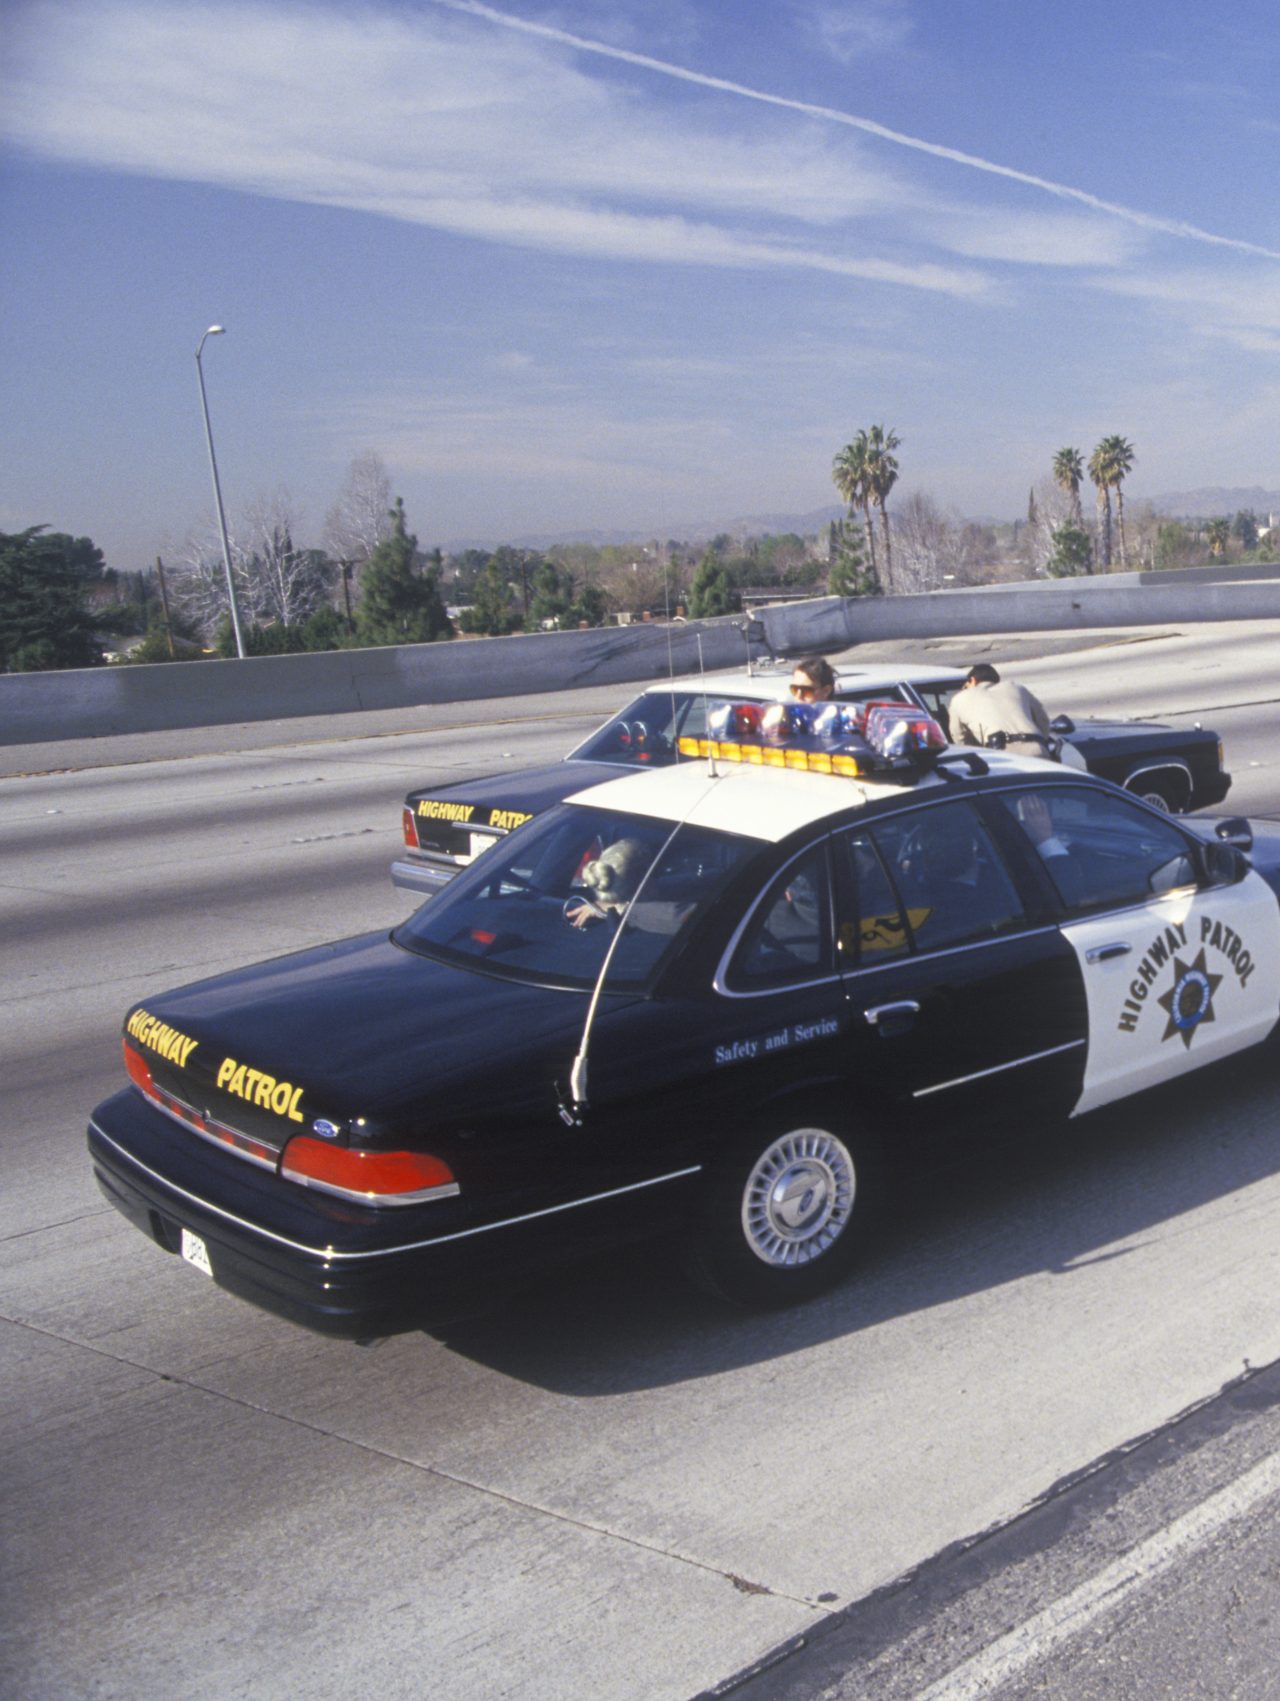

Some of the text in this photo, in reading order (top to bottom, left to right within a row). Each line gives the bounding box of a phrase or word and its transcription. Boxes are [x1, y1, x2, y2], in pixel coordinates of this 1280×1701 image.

[418, 800, 533, 829] HIGHWAY PATR
[1117, 923, 1188, 1033] HIGHWAY
[1201, 916, 1255, 989] PATROL
[127, 1008, 304, 1123] HIGHWAY PATROL
[715, 1018, 838, 1063] Safety and Service
